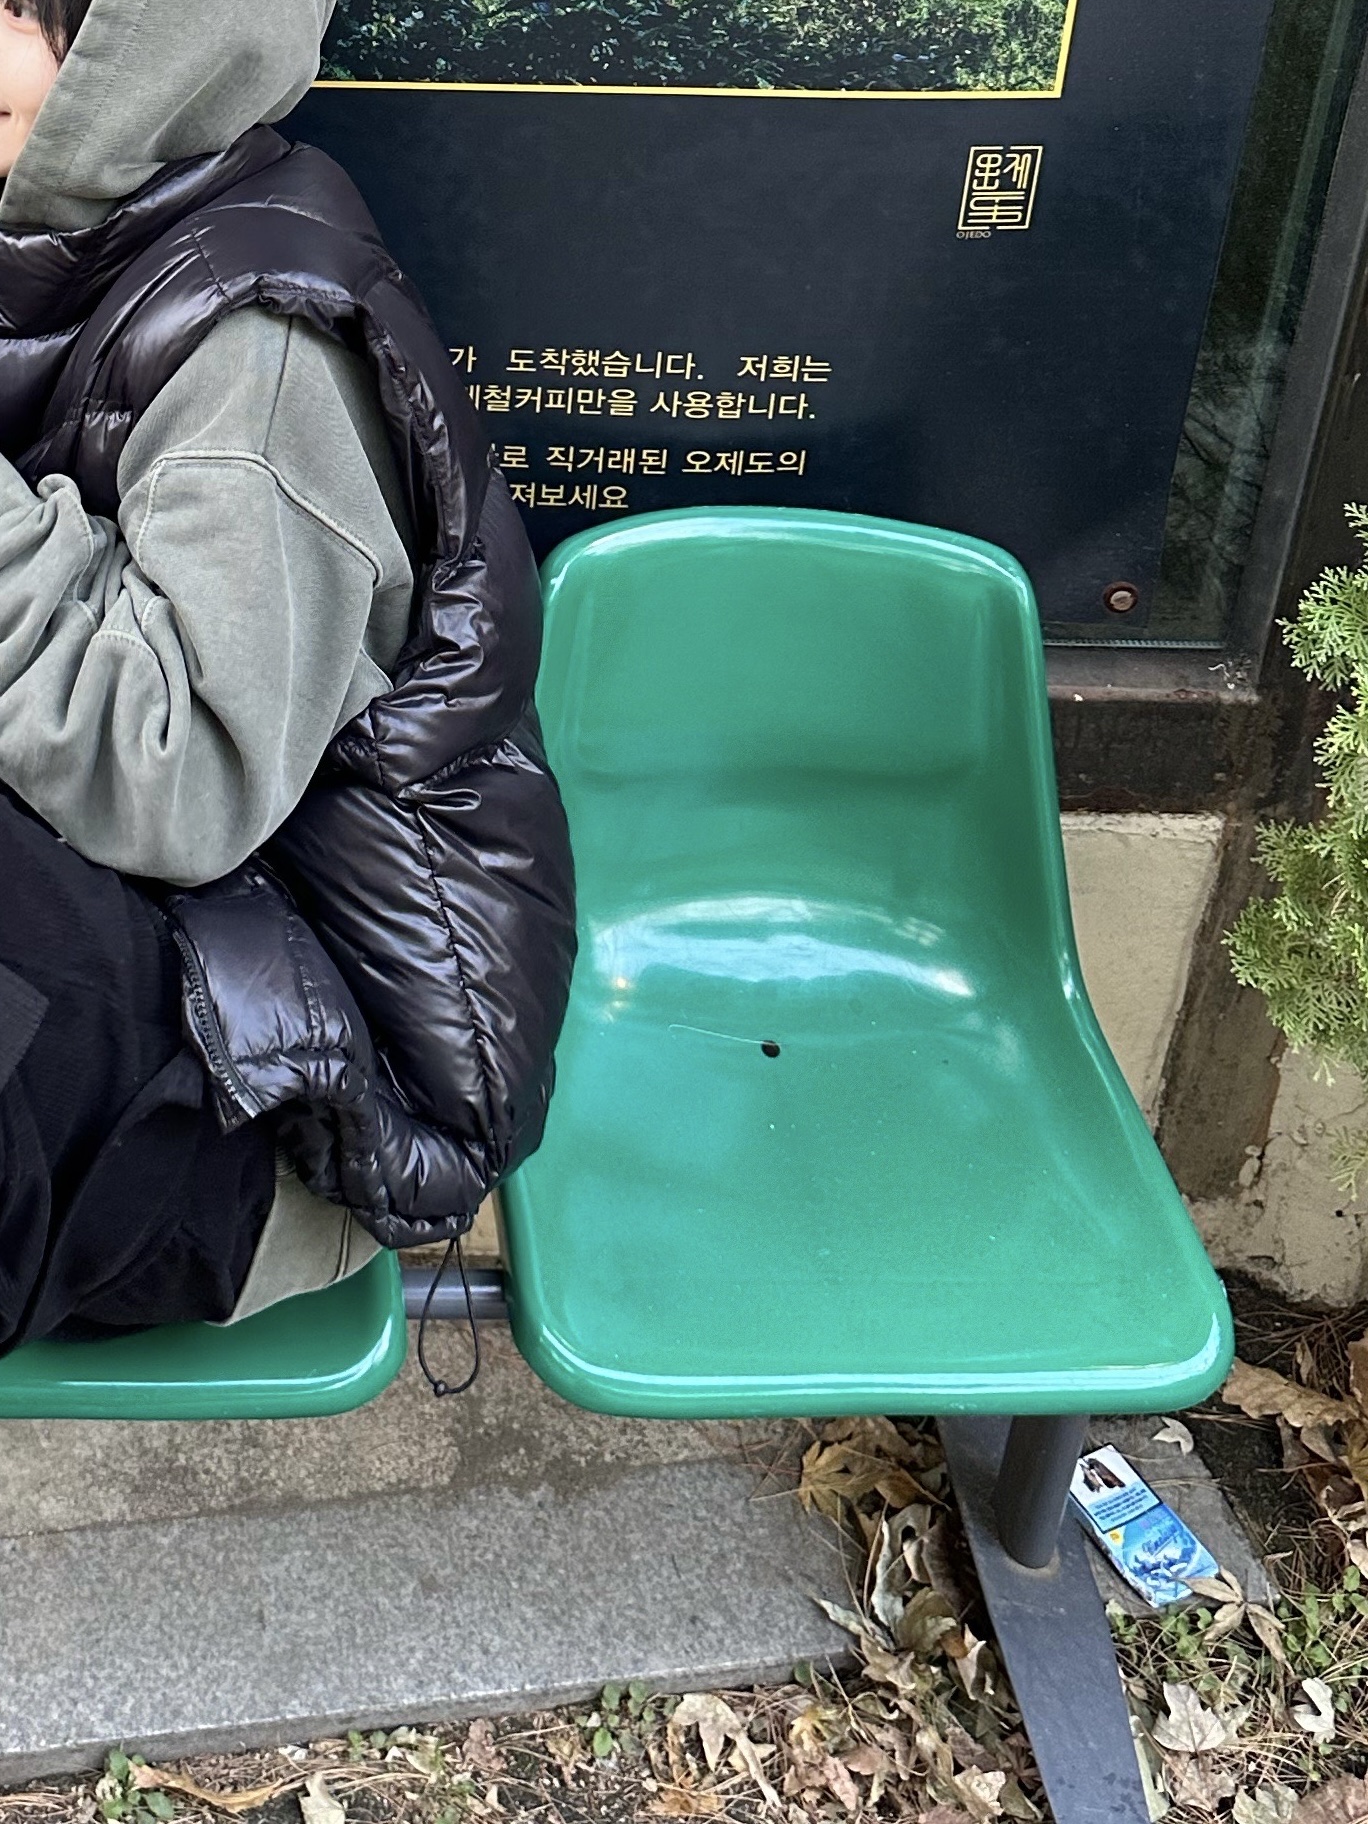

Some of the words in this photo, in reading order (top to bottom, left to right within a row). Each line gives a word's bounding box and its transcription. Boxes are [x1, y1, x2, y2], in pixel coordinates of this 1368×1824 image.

[956, 231, 991, 239] OJEDO
[505, 348, 705, 380] 도착했습니다.
[737, 354, 832, 383] 저희는
[649, 390, 816, 420] 사용합니다.
[545, 446, 668, 475] 직거래된
[681, 449, 806, 476] 오제도의
